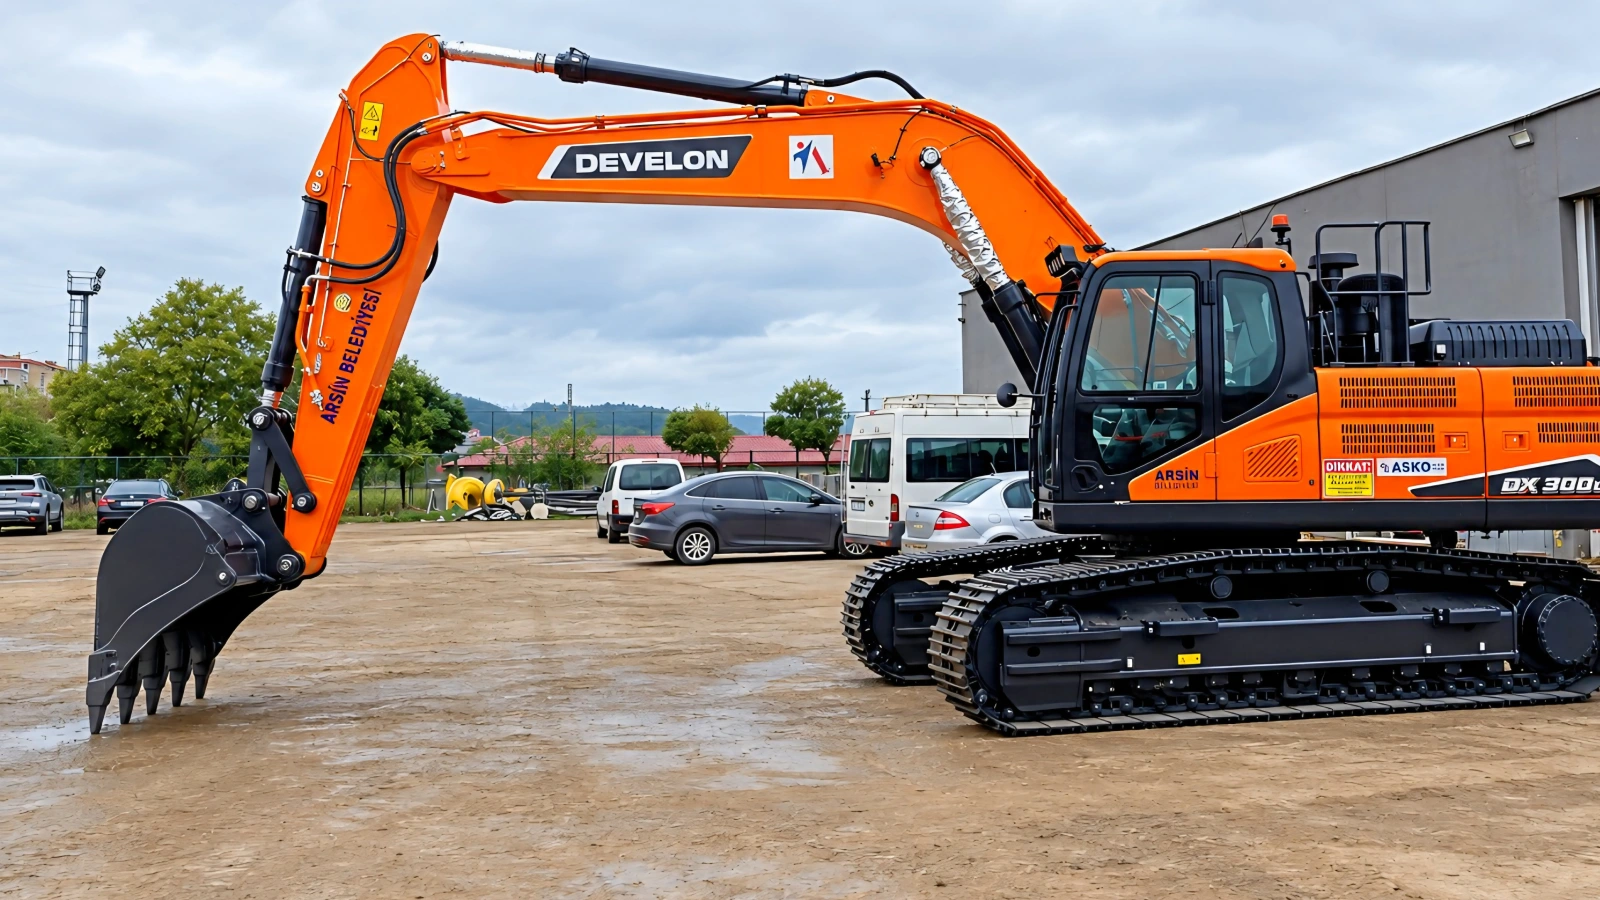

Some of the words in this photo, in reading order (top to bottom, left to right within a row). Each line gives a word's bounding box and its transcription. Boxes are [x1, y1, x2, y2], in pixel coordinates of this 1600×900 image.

[575, 149, 729, 173] DEVELON
[1155, 466, 1199, 481] ARSİN
[1392, 461, 1431, 473] ASKO
[1500, 477, 1541, 494] DX
